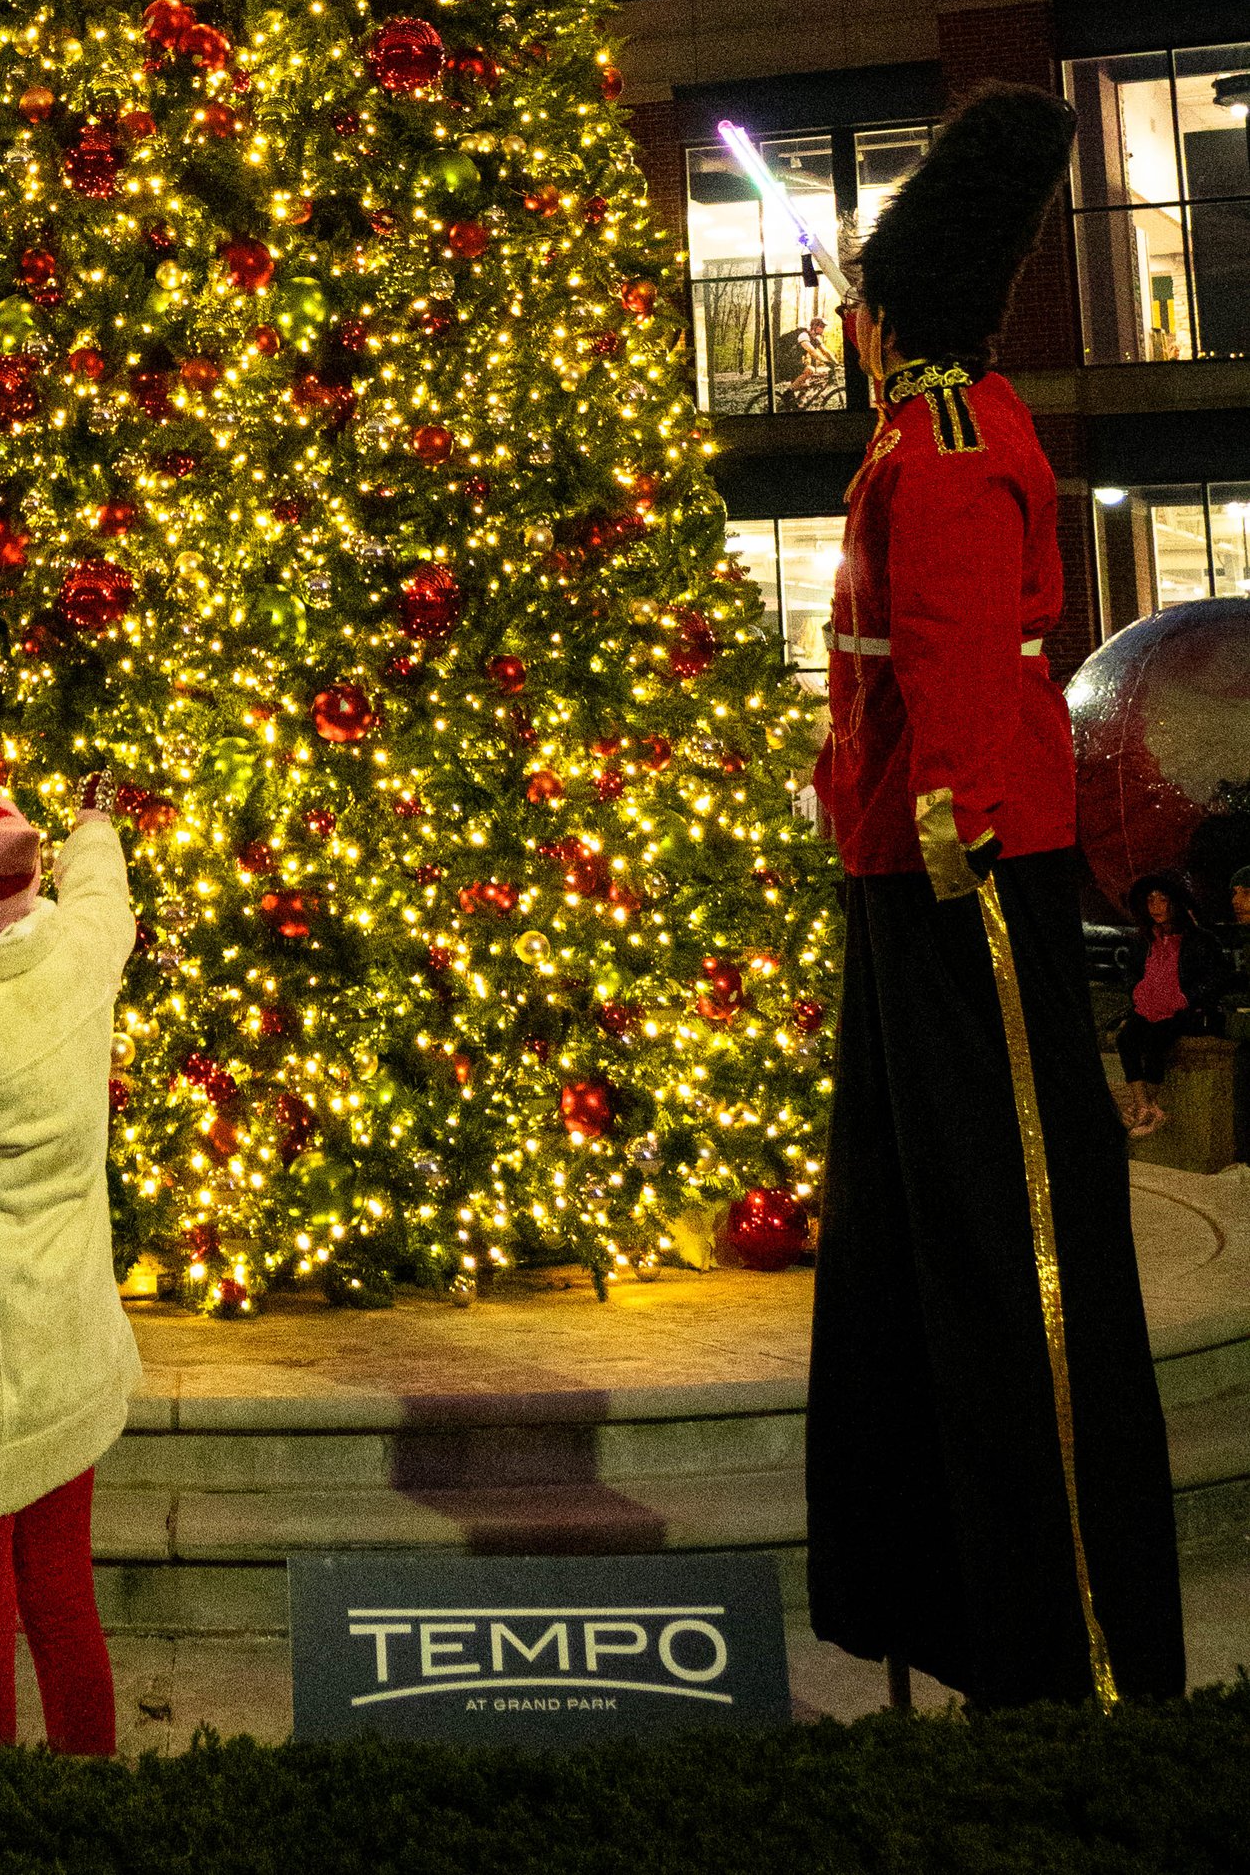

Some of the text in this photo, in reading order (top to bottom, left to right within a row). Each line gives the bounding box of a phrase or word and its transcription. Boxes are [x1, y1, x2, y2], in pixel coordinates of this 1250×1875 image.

[349, 1619, 727, 1682] TEMPO
[465, 1698, 617, 1711] AT GRAND PARK
